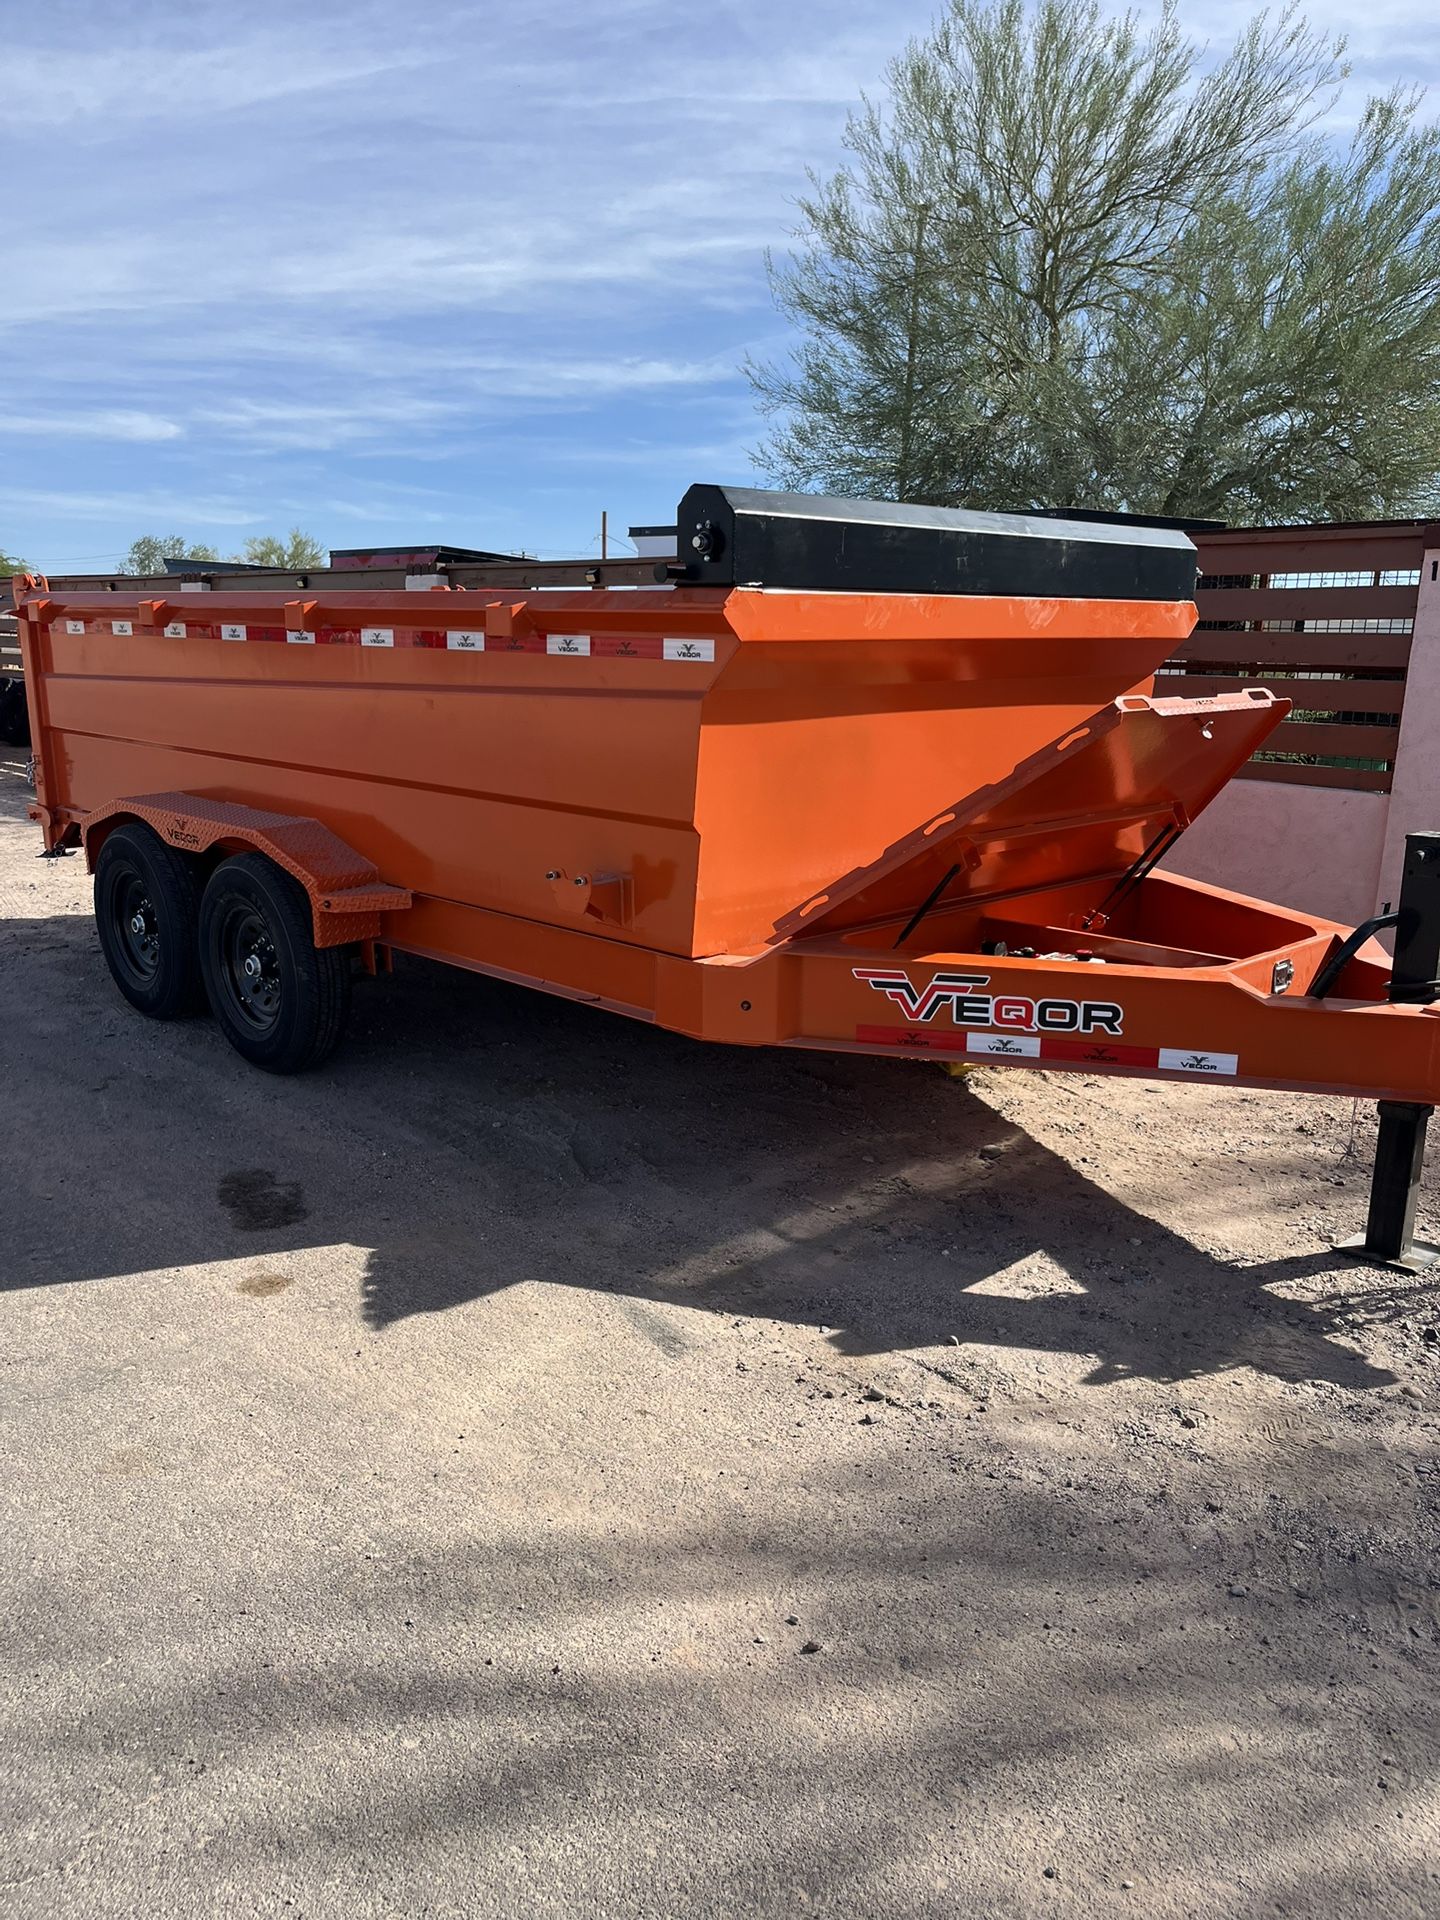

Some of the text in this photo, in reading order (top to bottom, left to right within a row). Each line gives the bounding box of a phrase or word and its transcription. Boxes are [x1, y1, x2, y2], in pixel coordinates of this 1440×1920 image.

[852, 968, 1123, 1035] VEQOR
[896, 1038, 930, 1046] VEQOR
[987, 1045, 1023, 1054] VEQOR
[1083, 1054, 1118, 1062] VEQOR
[1180, 1061, 1218, 1071] VEQOR
